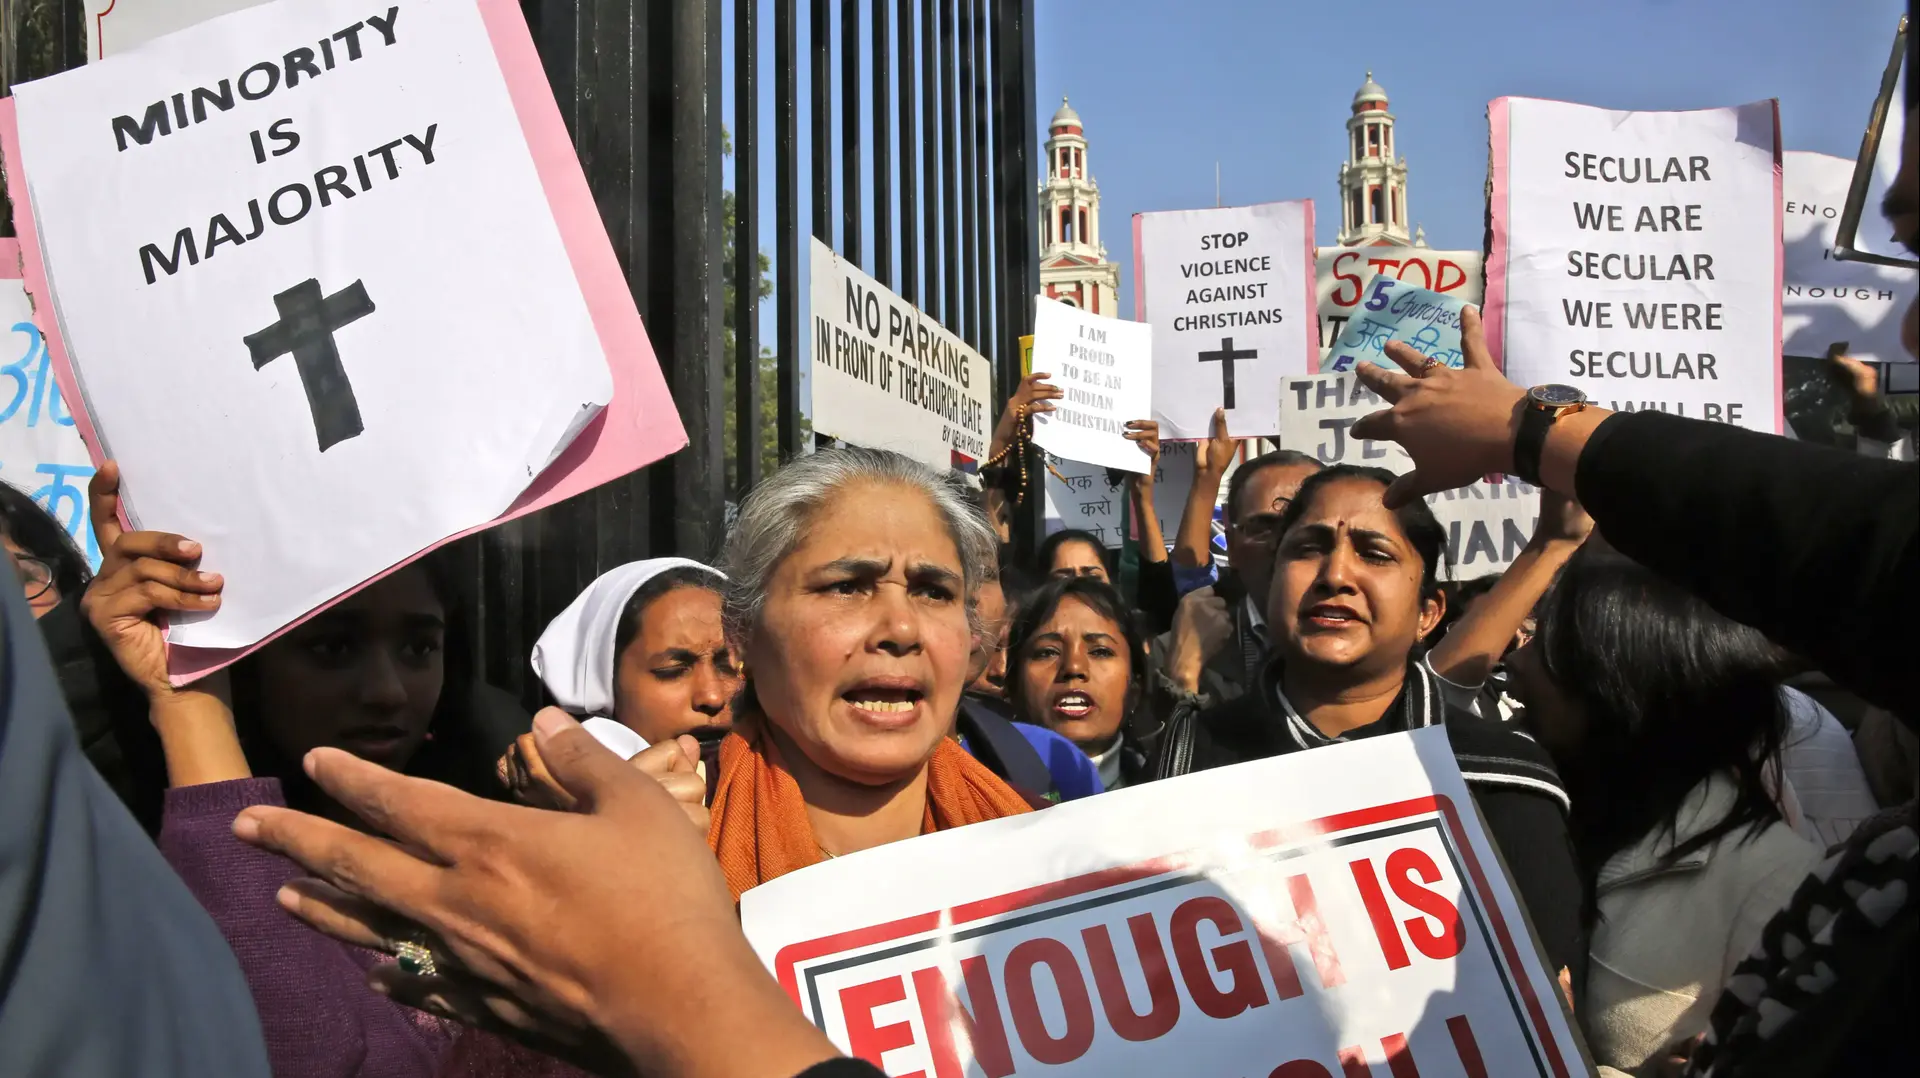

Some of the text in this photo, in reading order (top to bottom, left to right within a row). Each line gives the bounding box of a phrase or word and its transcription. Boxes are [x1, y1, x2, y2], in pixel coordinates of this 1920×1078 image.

[112, 5, 402, 152] MINORITY
[250, 118, 301, 164] IS
[1565, 151, 1711, 183] SECULAR
[138, 123, 440, 285] MAJORITY
[1573, 202, 1702, 232] WE ARE
[1786, 202, 1836, 219] ENO
[1201, 231, 1249, 250] STOP
[1180, 256, 1271, 278] VIOLENCE
[1567, 251, 1715, 280] SECULAR
[1186, 283, 1268, 305] AGAINST
[1364, 281, 1395, 312] 5
[1787, 285, 1894, 301] NOUGH
[1174, 308, 1283, 331] CHRISTIANS
[1562, 299, 1722, 330] WE WERE
[846, 276, 970, 389] NO PARKING
[1078, 325, 1107, 344] I AM
[1069, 343, 1115, 367] PROUD
[1569, 350, 1718, 379] SECULAR
[816, 315, 983, 436] IN FRONT OF THE CHURCH GATE
[1061, 362, 1122, 390] TO BE AN
[1068, 387, 1114, 411] INDIAN
[1055, 406, 1125, 435] CHRISTIAN
[942, 424, 983, 458] BY DELHI POLICE
[1066, 475, 1093, 493] एक
[1079, 495, 1111, 516] करो
[839, 847, 1467, 1078] ENOUGH IS
